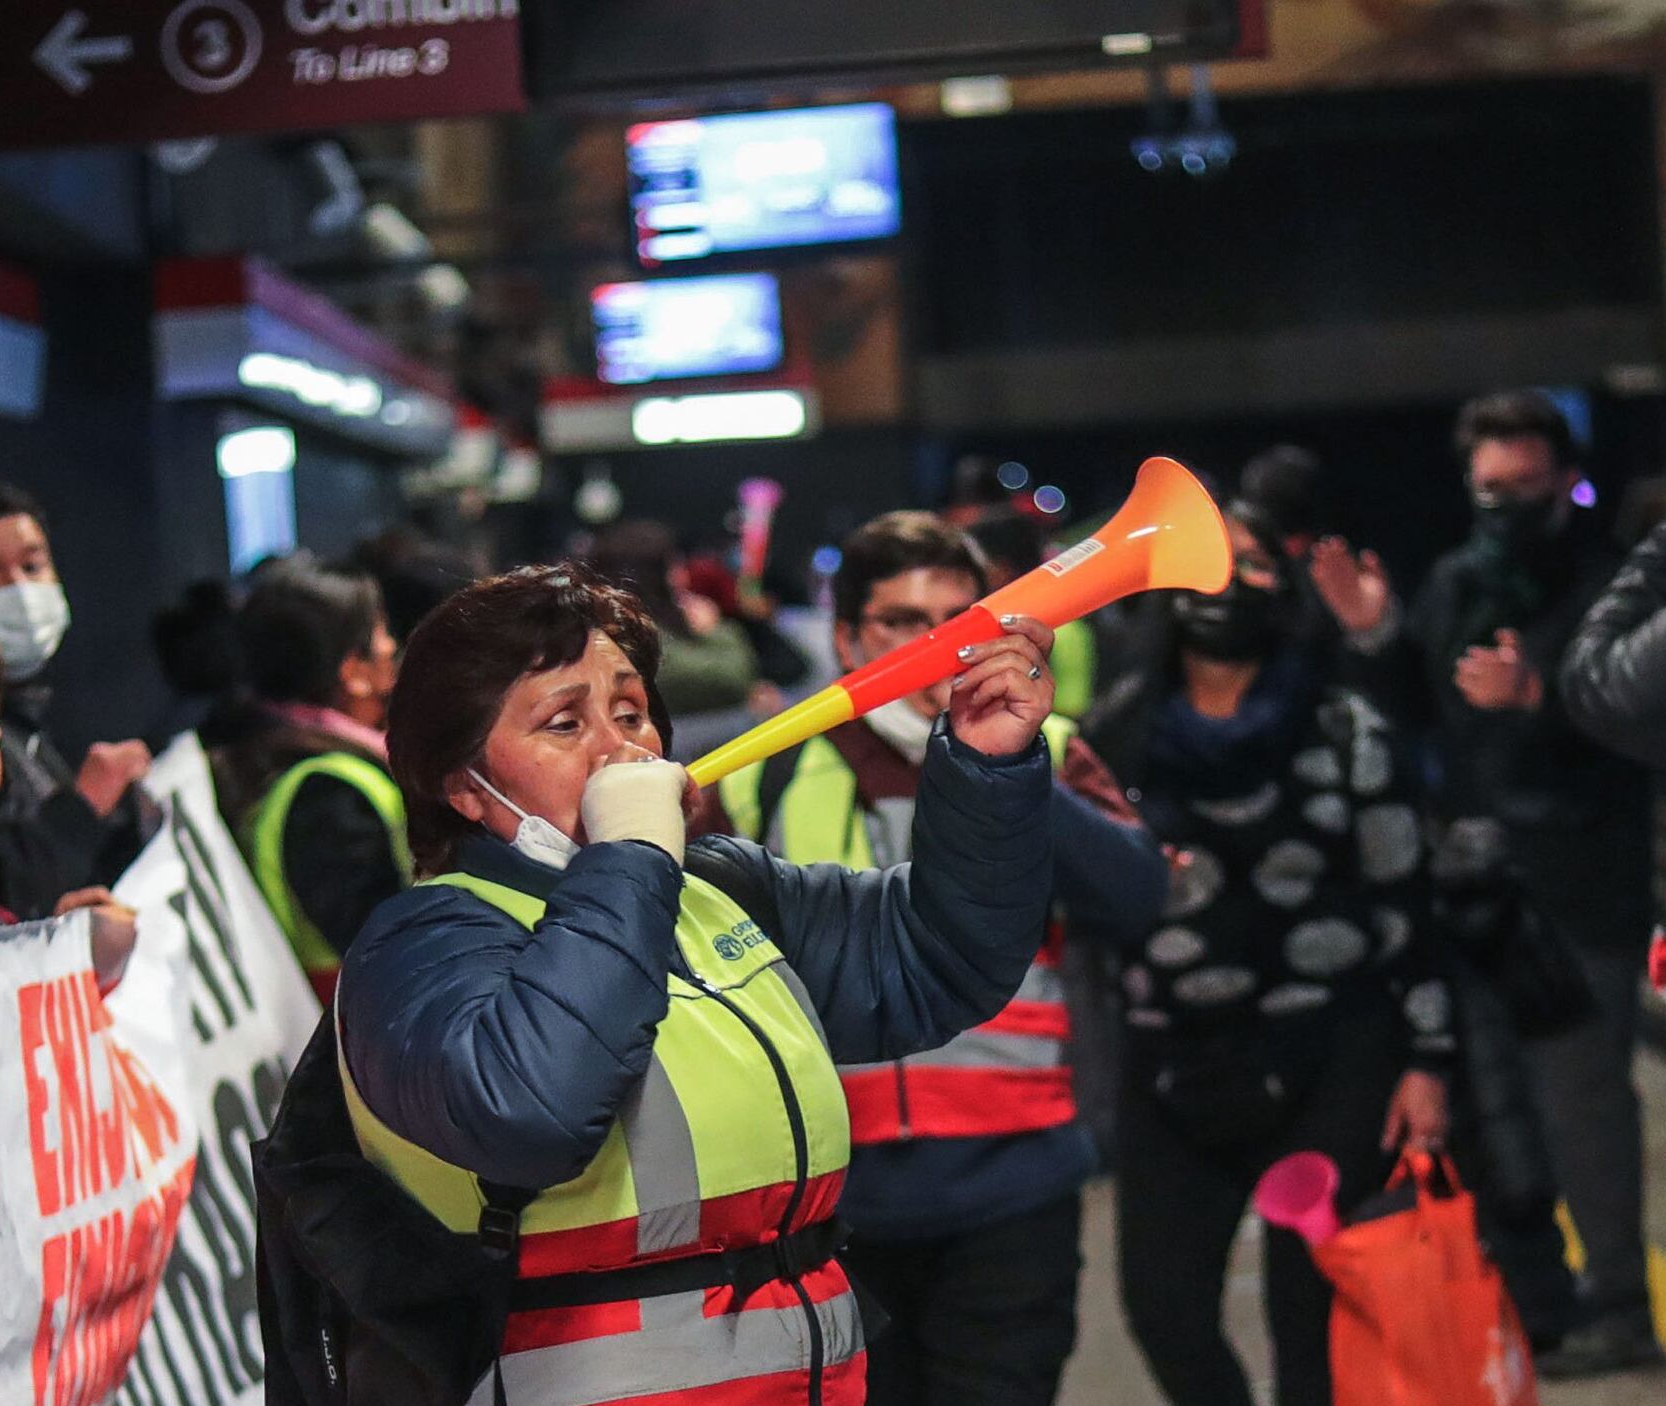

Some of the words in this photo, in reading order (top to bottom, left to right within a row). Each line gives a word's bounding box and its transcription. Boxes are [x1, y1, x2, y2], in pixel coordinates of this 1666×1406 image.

[194, 19, 229, 67] 3
[290, 47, 335, 86] To
[338, 43, 416, 83] Line
[417, 37, 451, 77] 3
